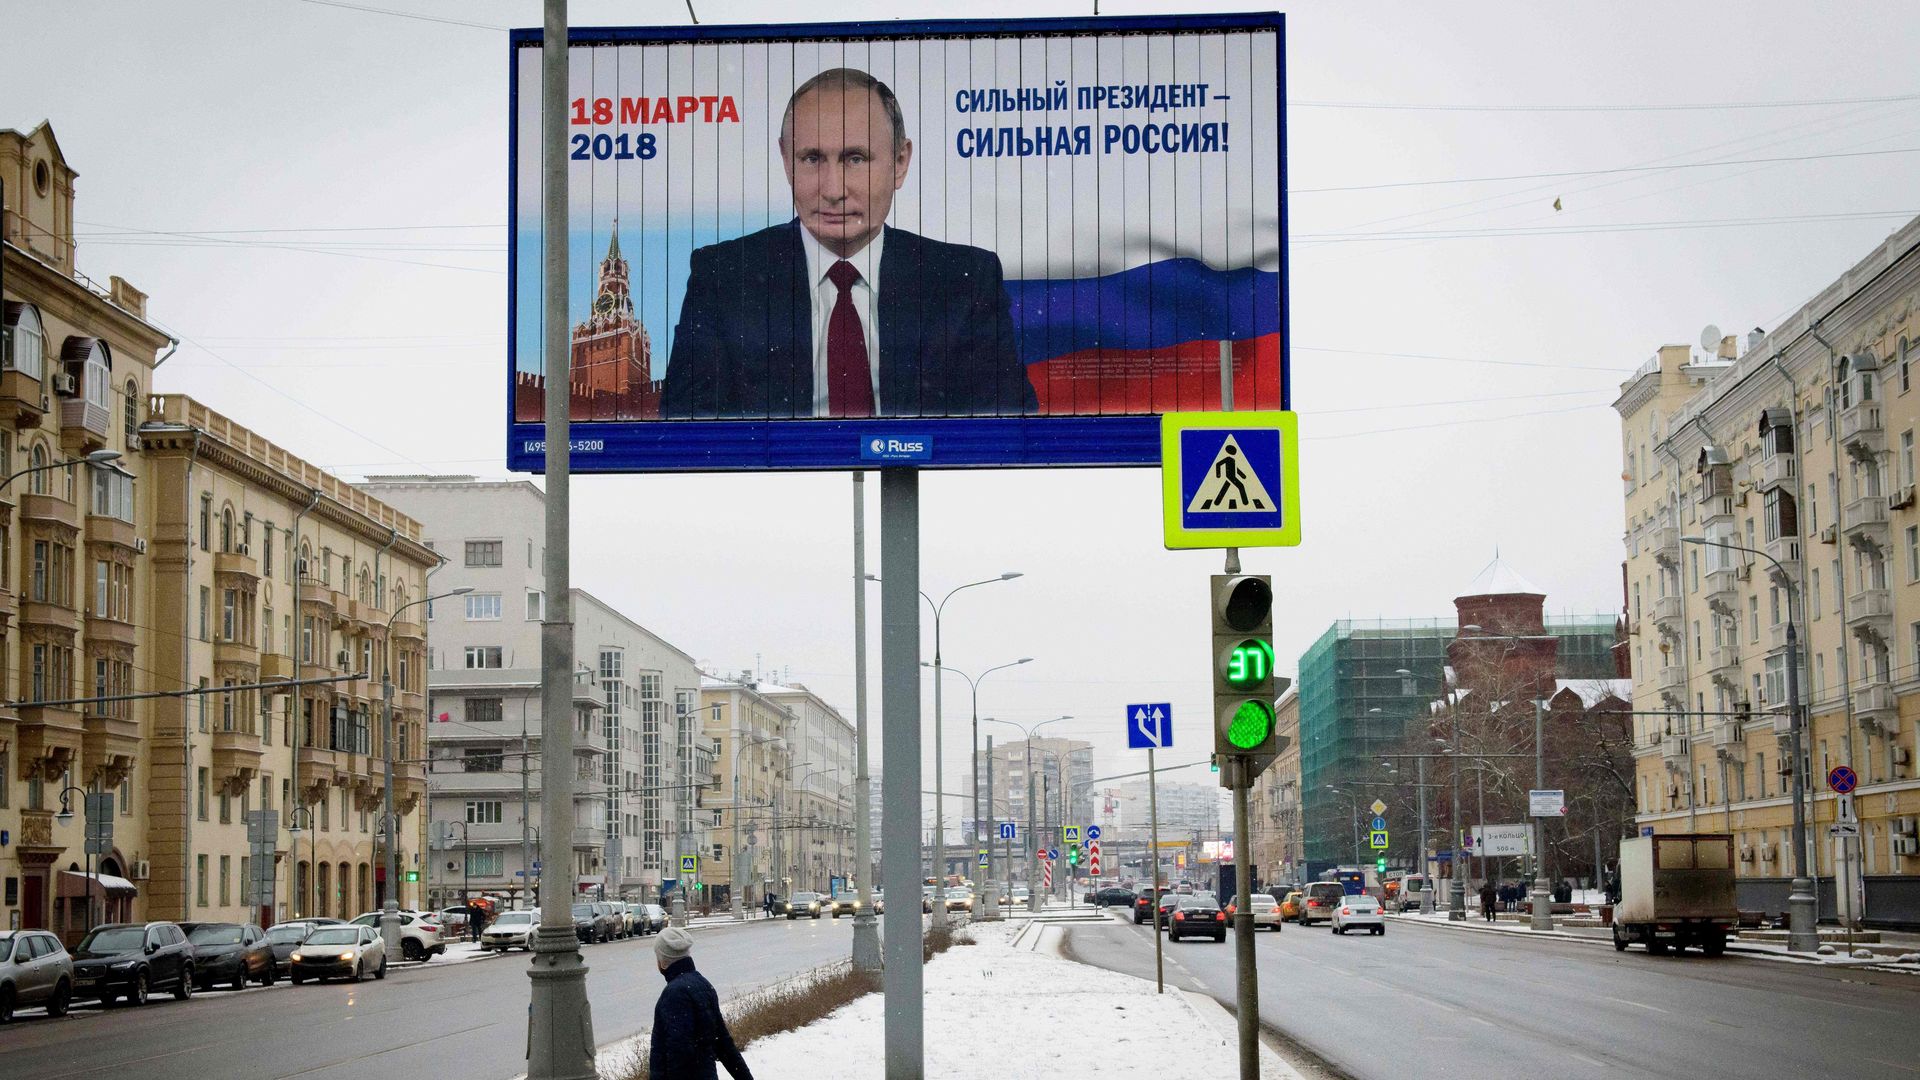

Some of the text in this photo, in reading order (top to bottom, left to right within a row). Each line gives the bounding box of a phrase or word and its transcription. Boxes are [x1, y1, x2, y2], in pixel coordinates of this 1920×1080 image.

[571, 96, 740, 125] 18 МАРТА
[955, 81, 1068, 113] СИЛЬНЫЙ
[1077, 84, 1209, 113] ПРЕЗИДЕНТ
[571, 133, 657, 160] 2018
[956, 122, 1230, 158] СИЛЬНАЯ РОССИЯ!
[888, 440, 924, 452] Russ
[1229, 649, 1264, 680] 37
